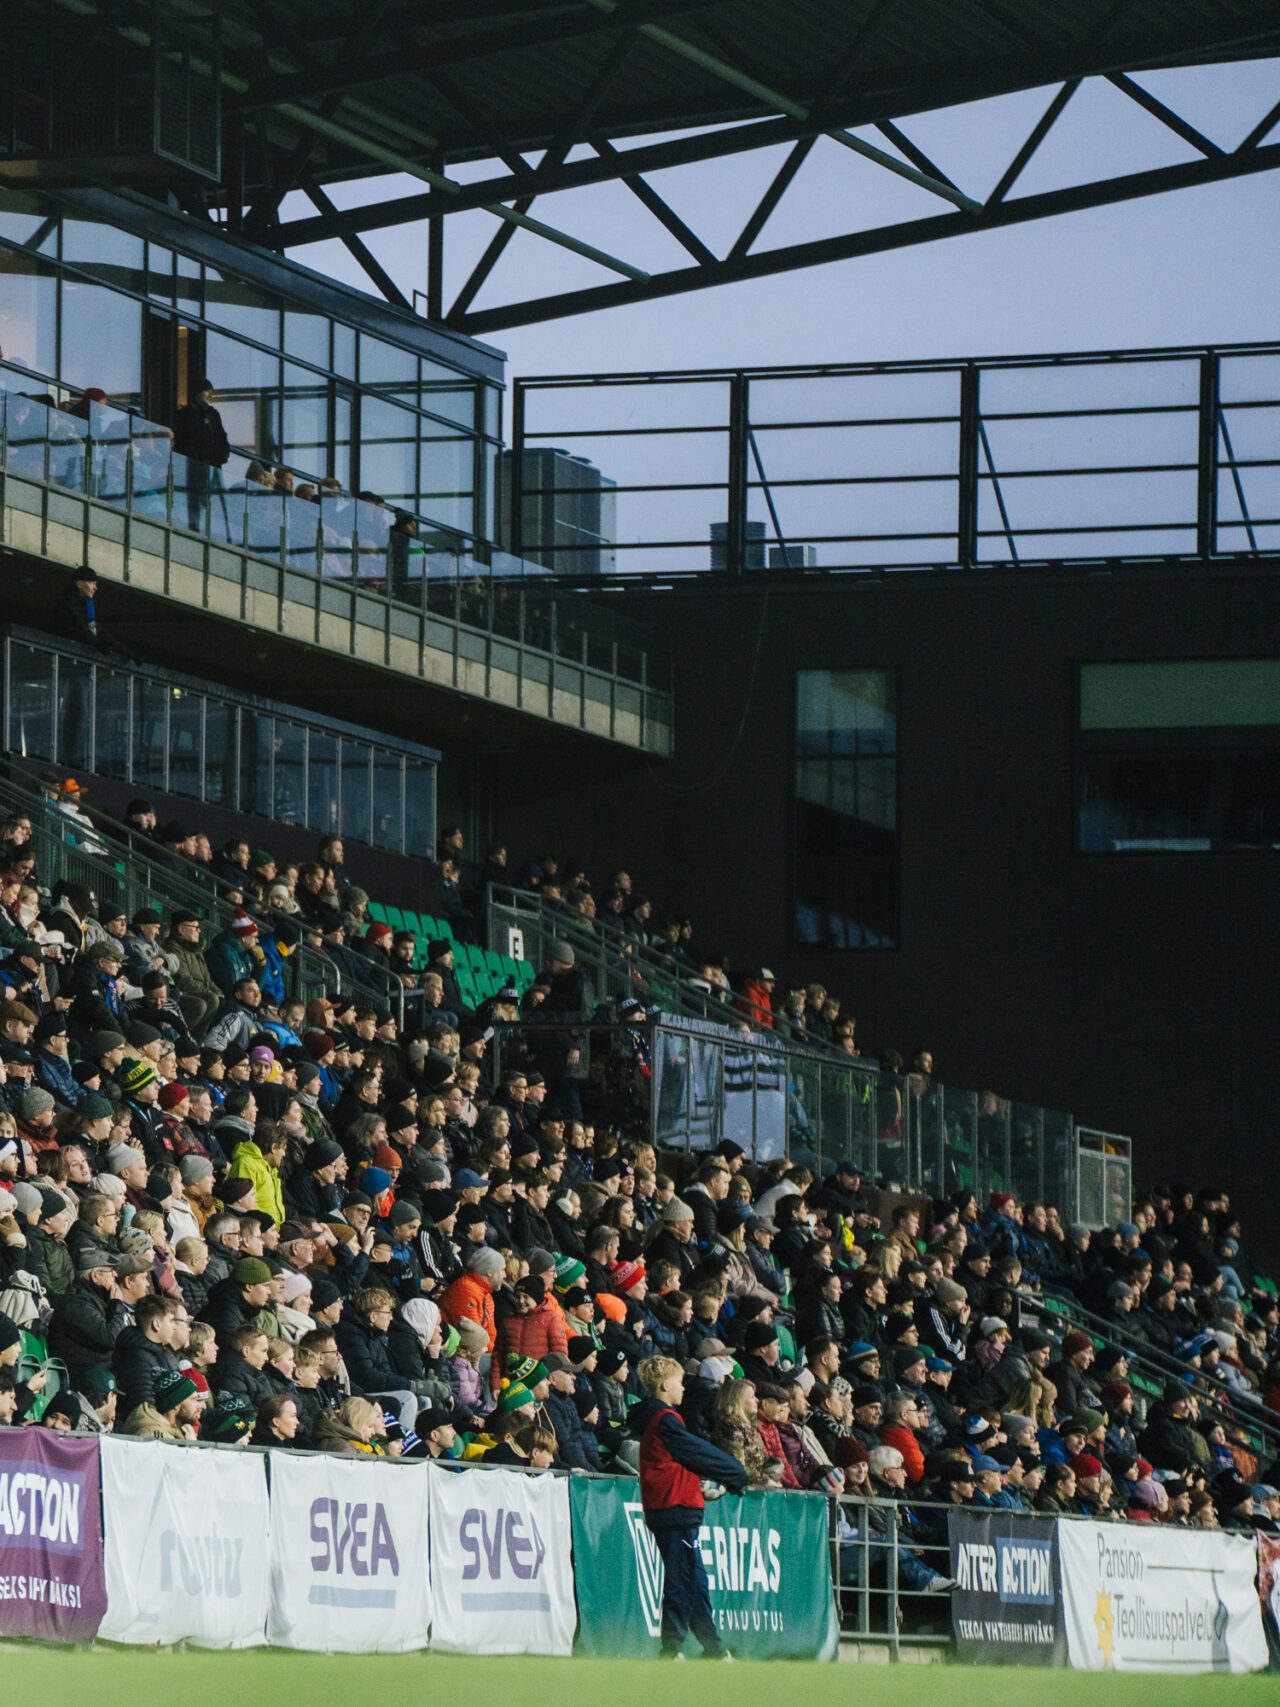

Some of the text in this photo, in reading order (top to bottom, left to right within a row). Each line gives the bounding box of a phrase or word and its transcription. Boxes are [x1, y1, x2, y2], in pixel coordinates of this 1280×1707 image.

[310, 1497, 399, 1577] SVEA
[699, 1526, 781, 1593] ERITAS
[1097, 1532, 1143, 1580] Pansion
[1002, 1546, 1050, 1596] ACTION
[1114, 1593, 1213, 1655] Teollisuuspalvelu
